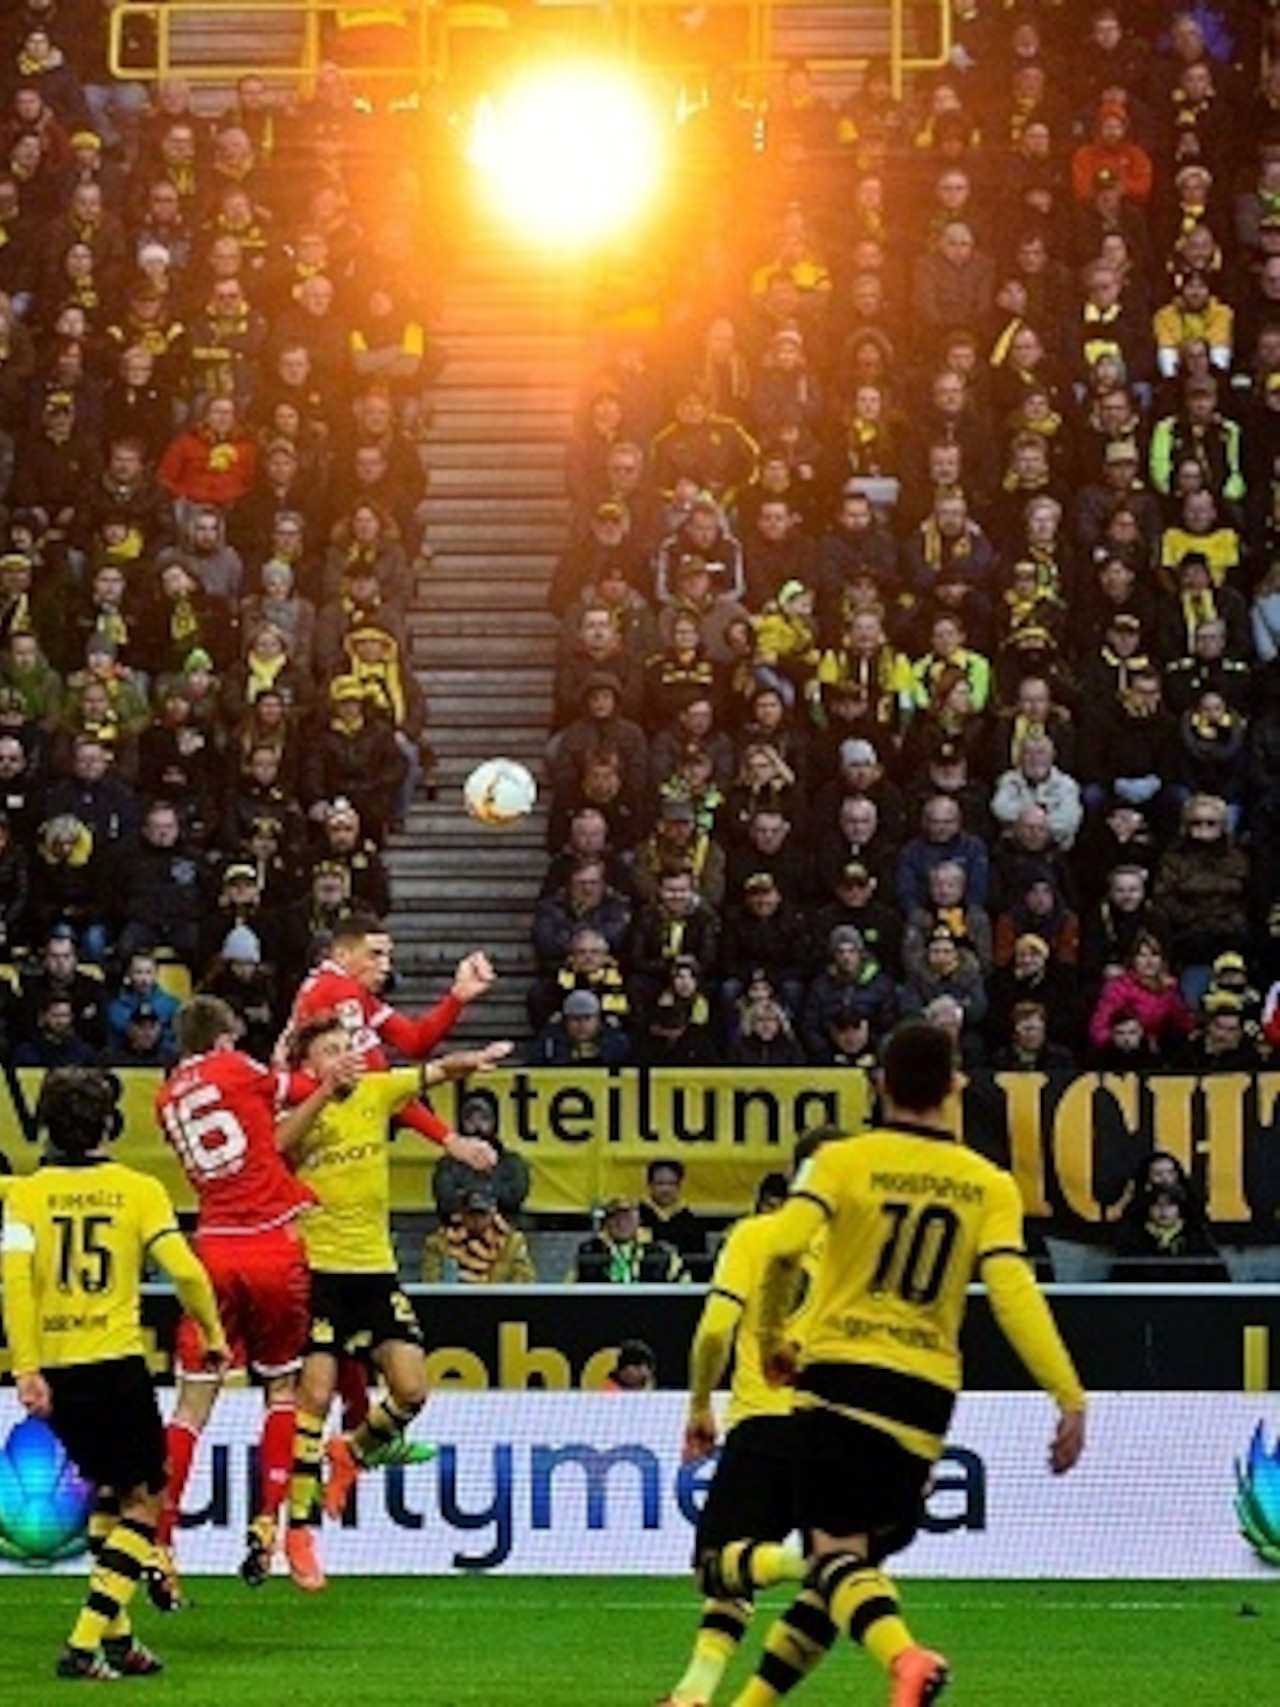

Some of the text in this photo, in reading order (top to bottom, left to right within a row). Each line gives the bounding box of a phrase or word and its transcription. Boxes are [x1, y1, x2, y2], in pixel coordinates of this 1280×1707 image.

[161, 1083, 248, 1172] 16
[51, 1214, 113, 1293] 15
[868, 1204, 960, 1304] 10
